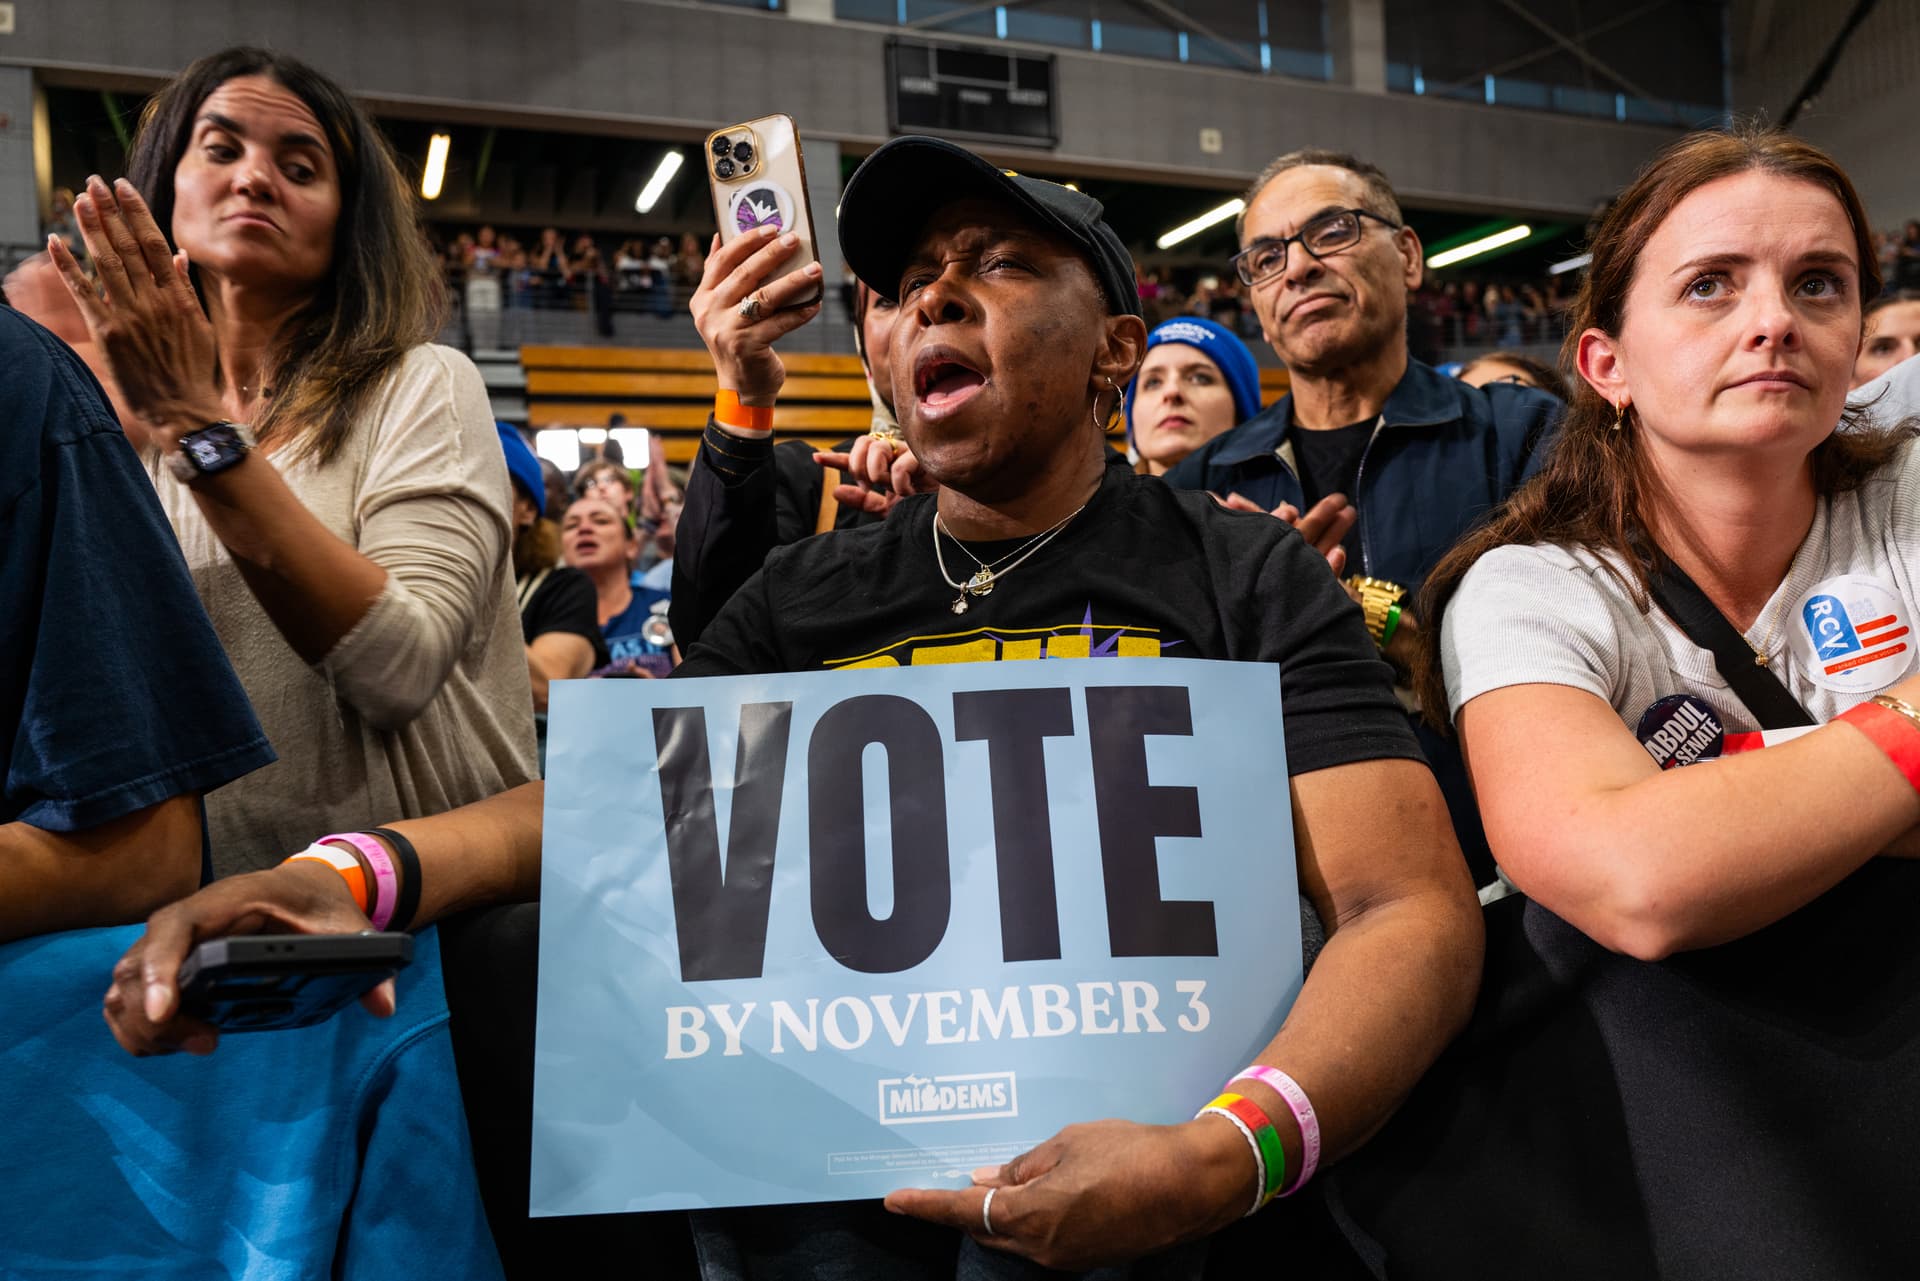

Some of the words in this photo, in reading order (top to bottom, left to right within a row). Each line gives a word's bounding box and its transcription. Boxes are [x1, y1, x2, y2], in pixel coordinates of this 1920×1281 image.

[1810, 599, 1849, 650] RCV
[1644, 700, 1708, 764] ABDUL
[1675, 716, 1723, 762] SENATE
[652, 686, 1220, 982] VOTE
[665, 1002, 757, 1059] BY
[770, 982, 1166, 1053] NOVEMBER
[1176, 981, 1210, 1032] 3
